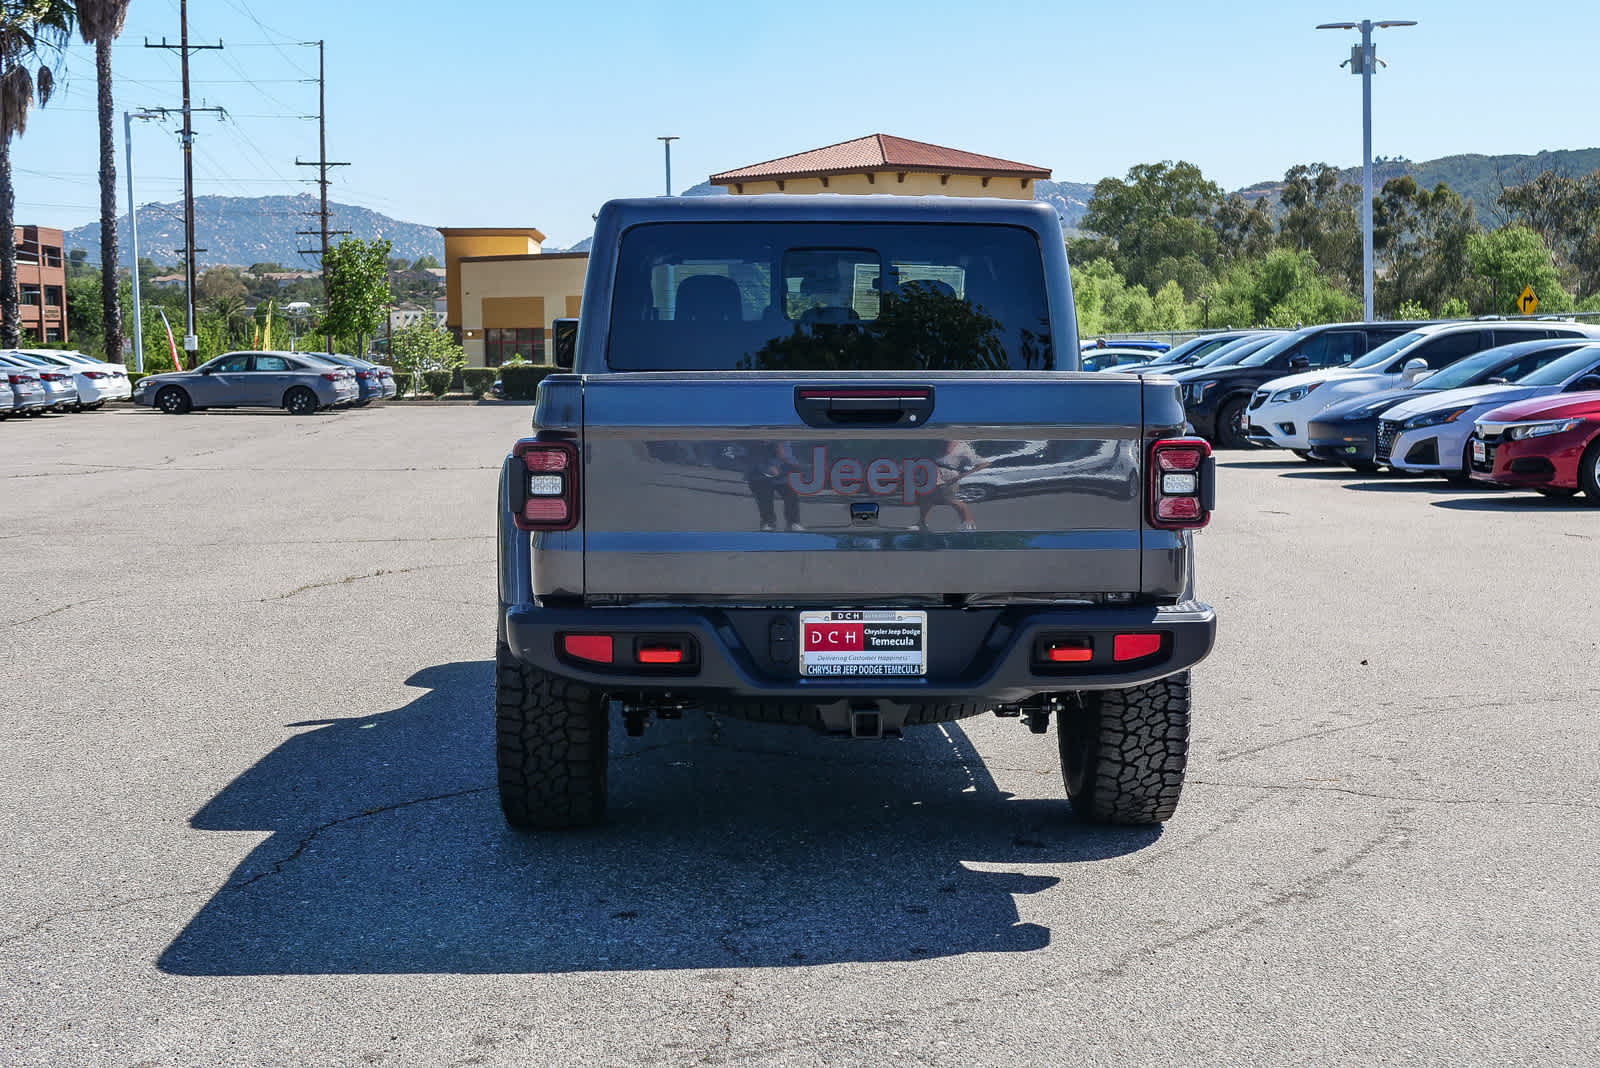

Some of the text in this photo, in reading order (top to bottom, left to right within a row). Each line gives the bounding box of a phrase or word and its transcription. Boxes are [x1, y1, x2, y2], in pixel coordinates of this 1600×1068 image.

[788, 446, 938, 504] Jeep
[864, 628, 921, 636] Chrysler Jeep Dodge
[871, 637, 915, 646] Temecula
[808, 665, 920, 675] CHRYSLER JEEP DODGE TEMECULA
